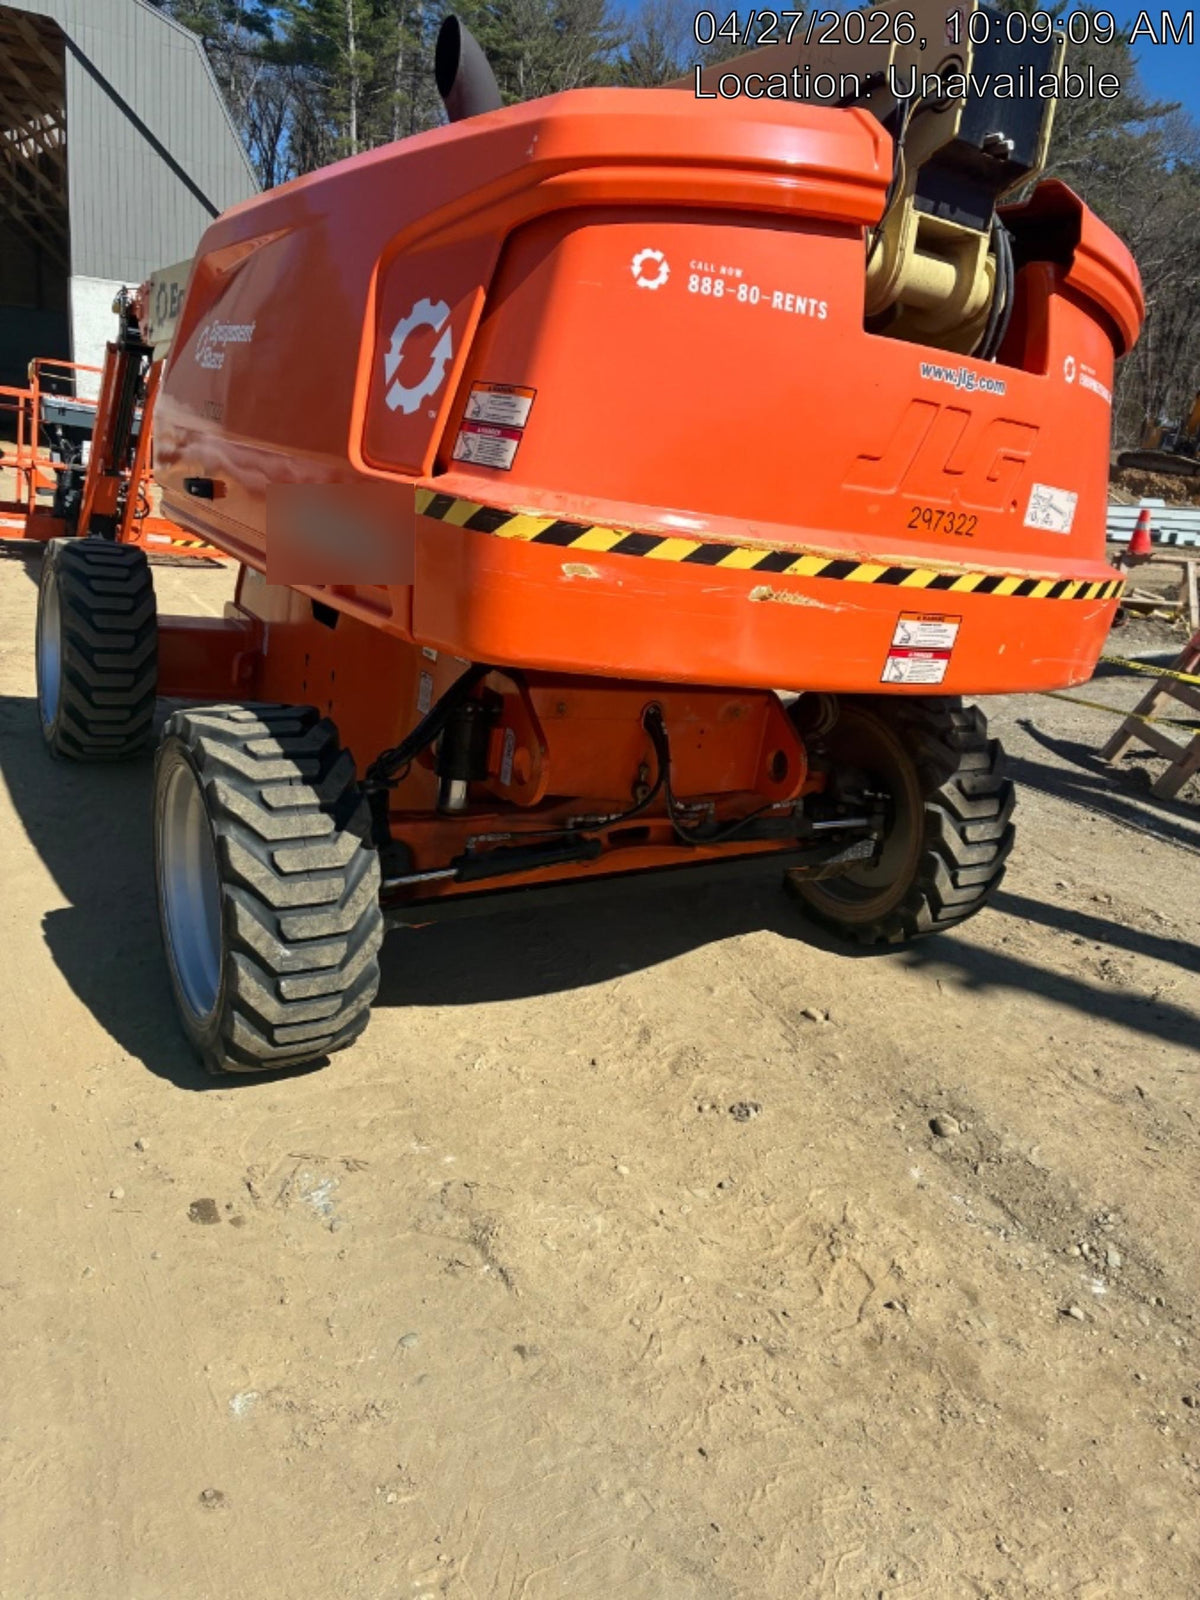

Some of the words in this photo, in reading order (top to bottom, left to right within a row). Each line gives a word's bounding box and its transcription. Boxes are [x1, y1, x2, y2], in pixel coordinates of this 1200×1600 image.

[689, 259, 716, 273] CALL
[719, 265, 744, 278] NOW
[687, 273, 829, 320] 888-80-RENTS
[919, 361, 1007, 396] www.jlg.com
[841, 397, 1041, 513] JLG
[907, 505, 979, 538] 297322
